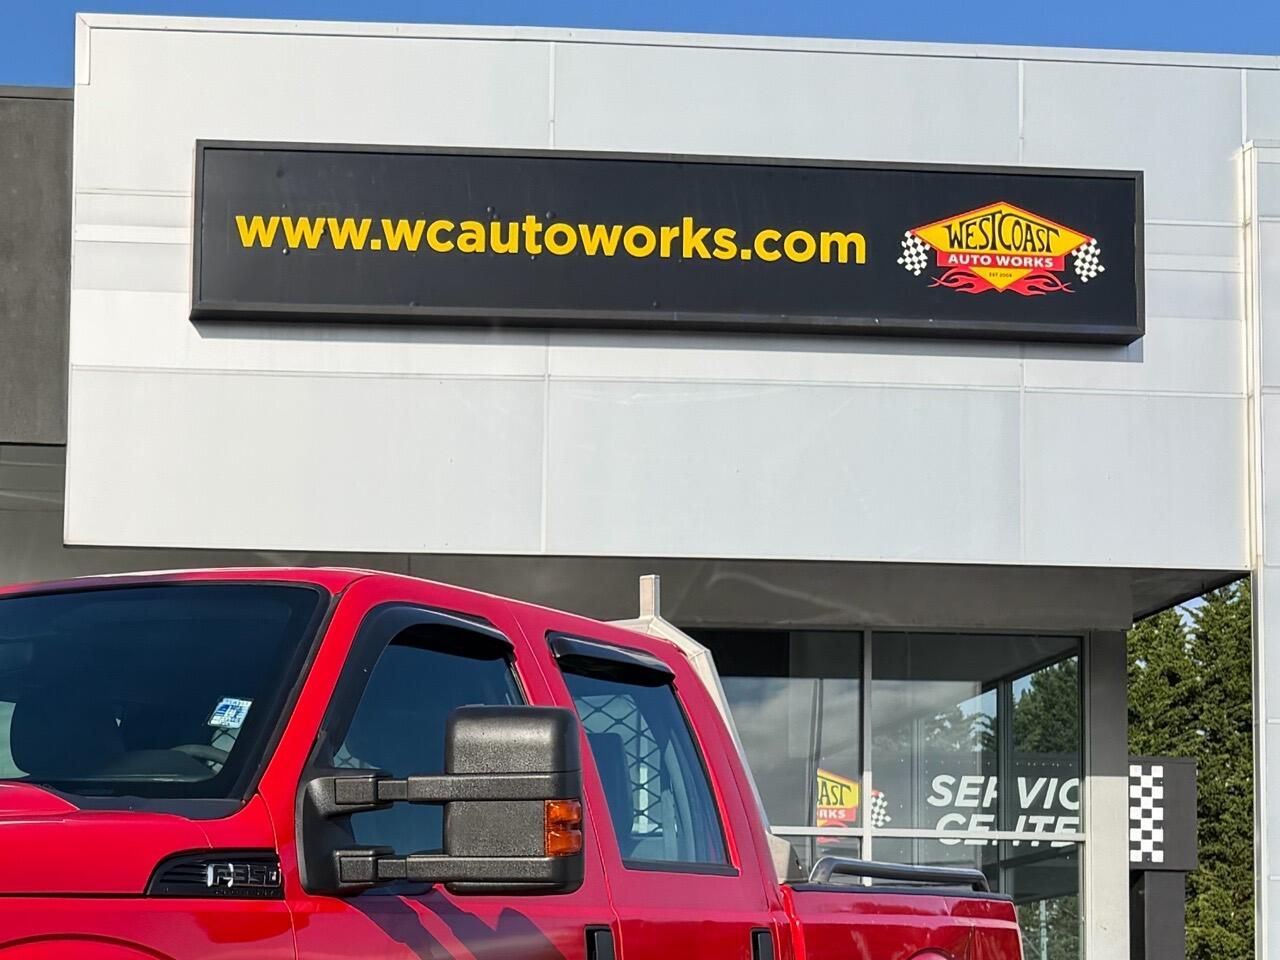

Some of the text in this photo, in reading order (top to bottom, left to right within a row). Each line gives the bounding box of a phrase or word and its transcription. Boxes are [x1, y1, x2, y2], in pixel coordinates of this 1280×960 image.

[235, 215, 867, 264] www.wcautoworks.com
[948, 254, 1054, 268] AUTO WORKS
